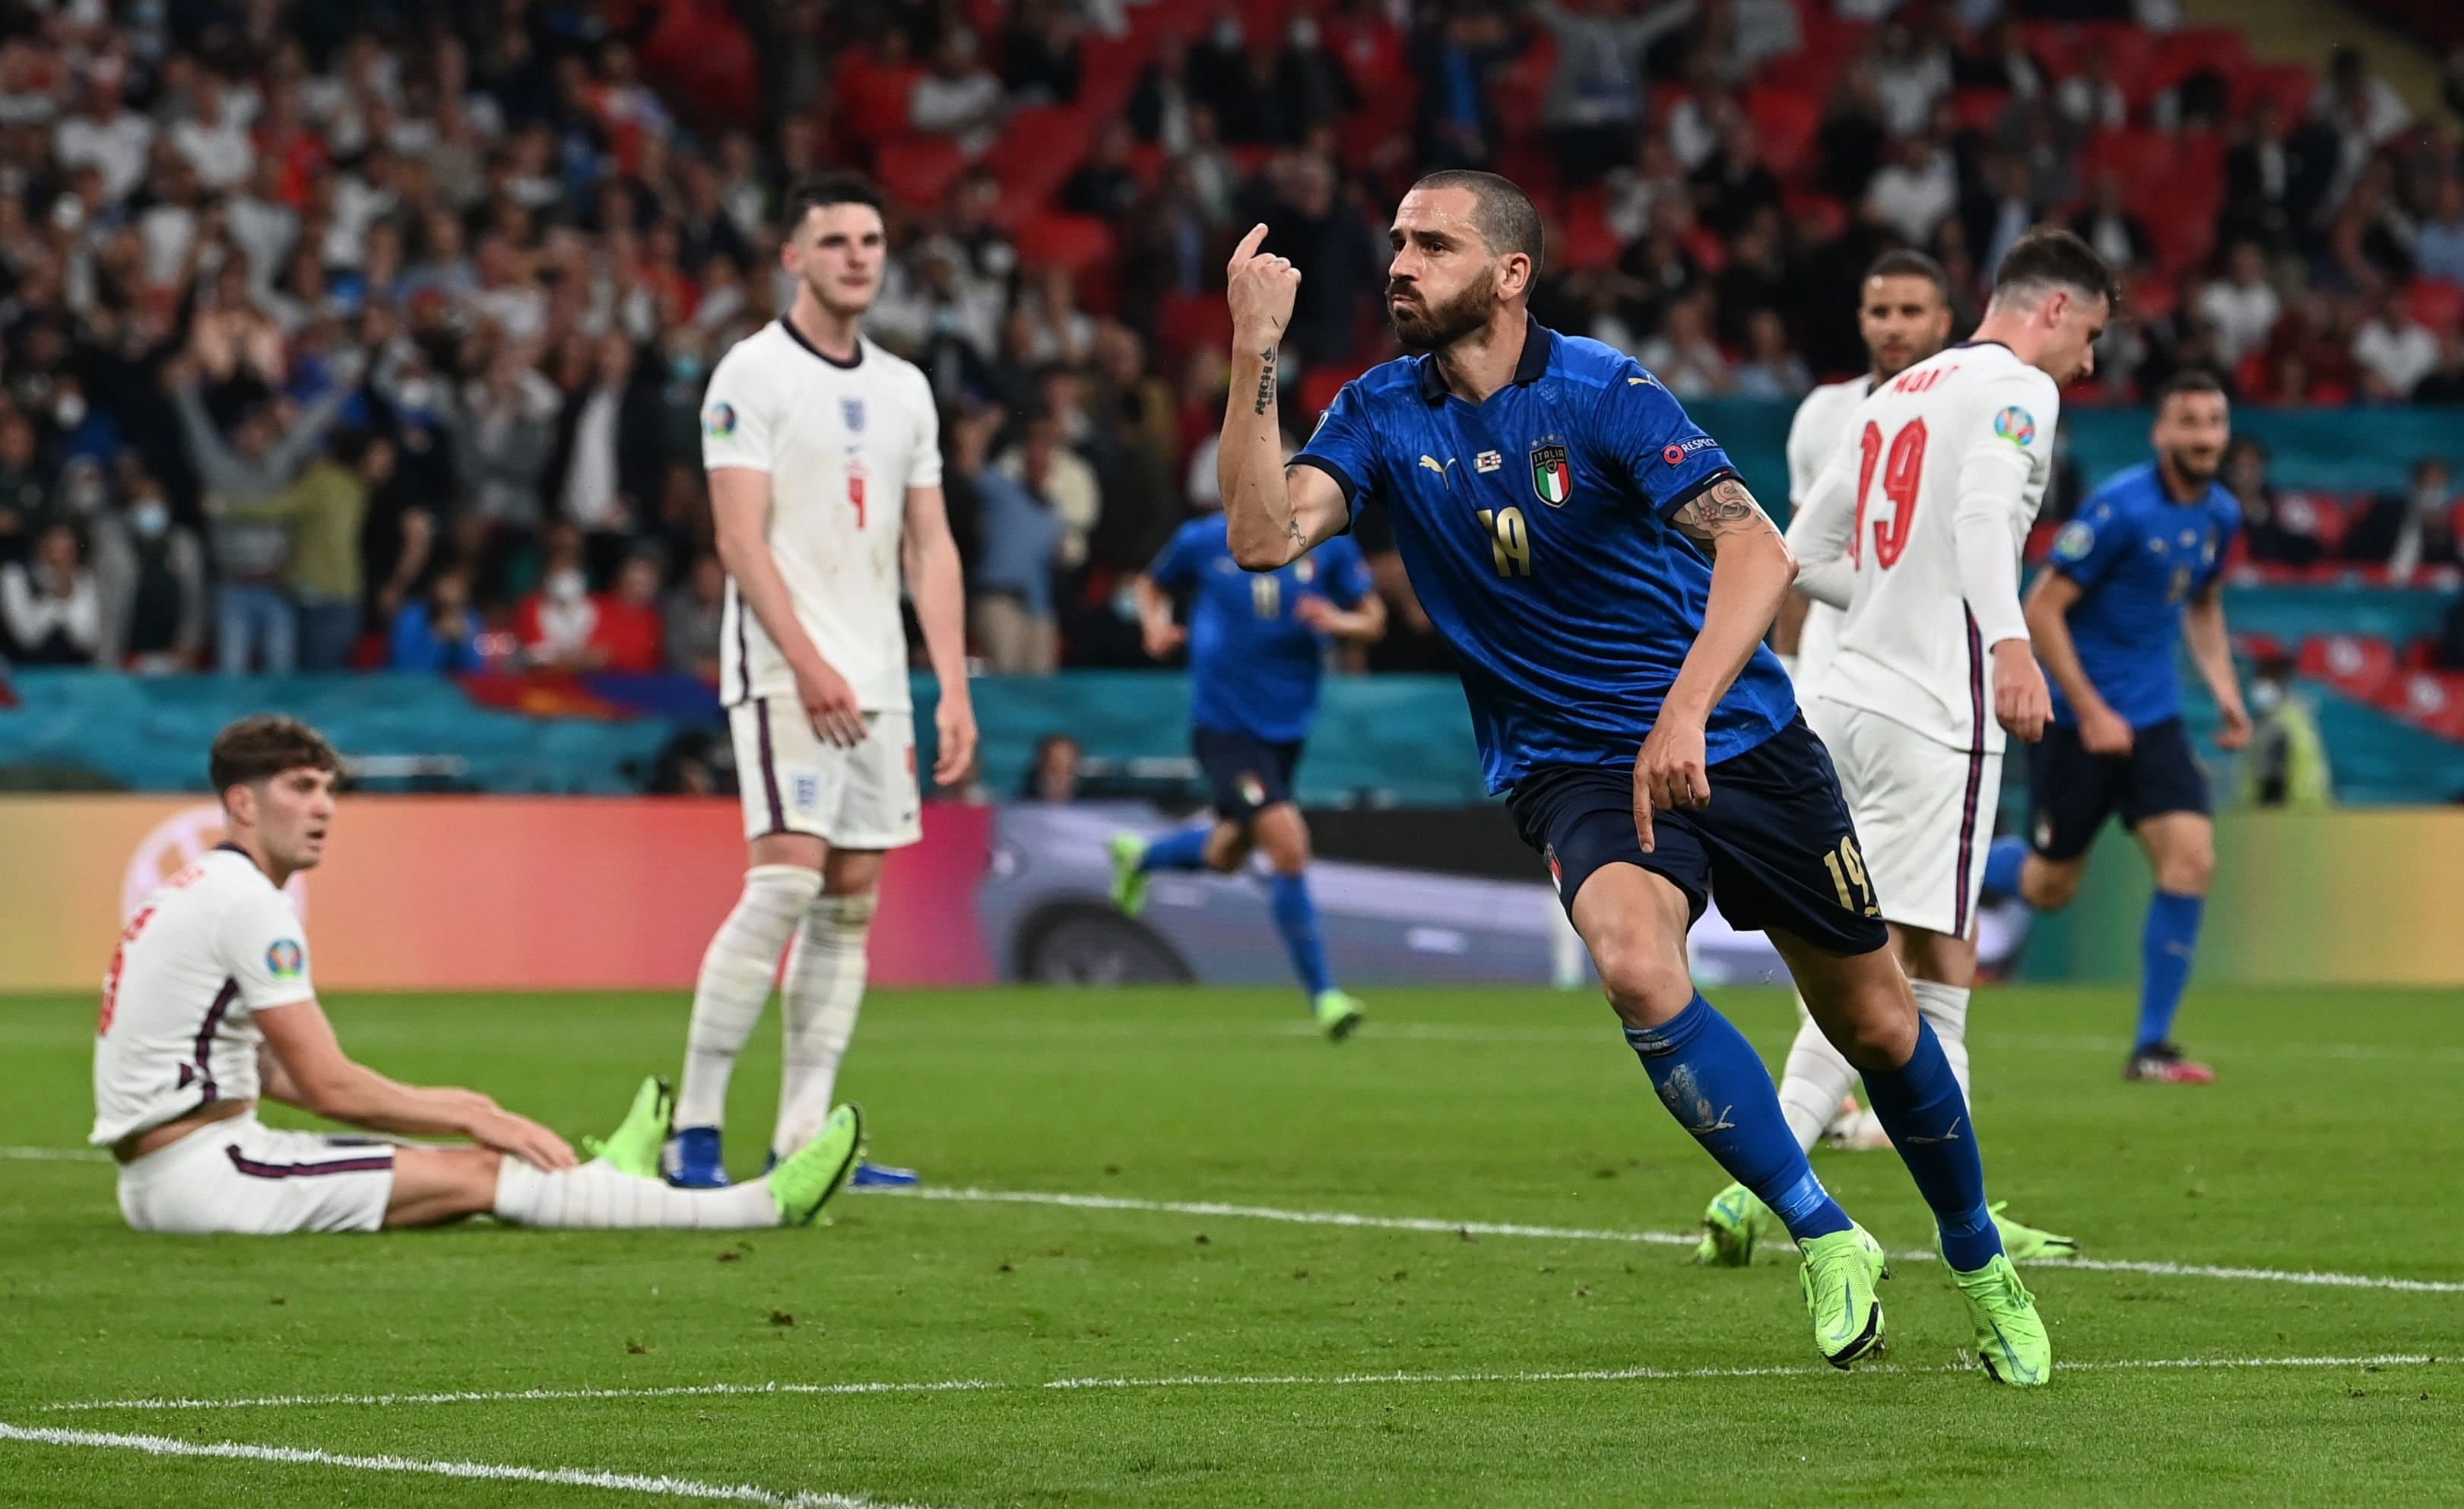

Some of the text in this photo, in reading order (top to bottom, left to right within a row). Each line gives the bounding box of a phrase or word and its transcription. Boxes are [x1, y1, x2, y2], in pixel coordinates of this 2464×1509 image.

[1534, 449, 1565, 463] ITALIA
[1851, 416, 1928, 571] 19
[1476, 506, 1530, 577] 19
[1824, 836, 1869, 911] 19
